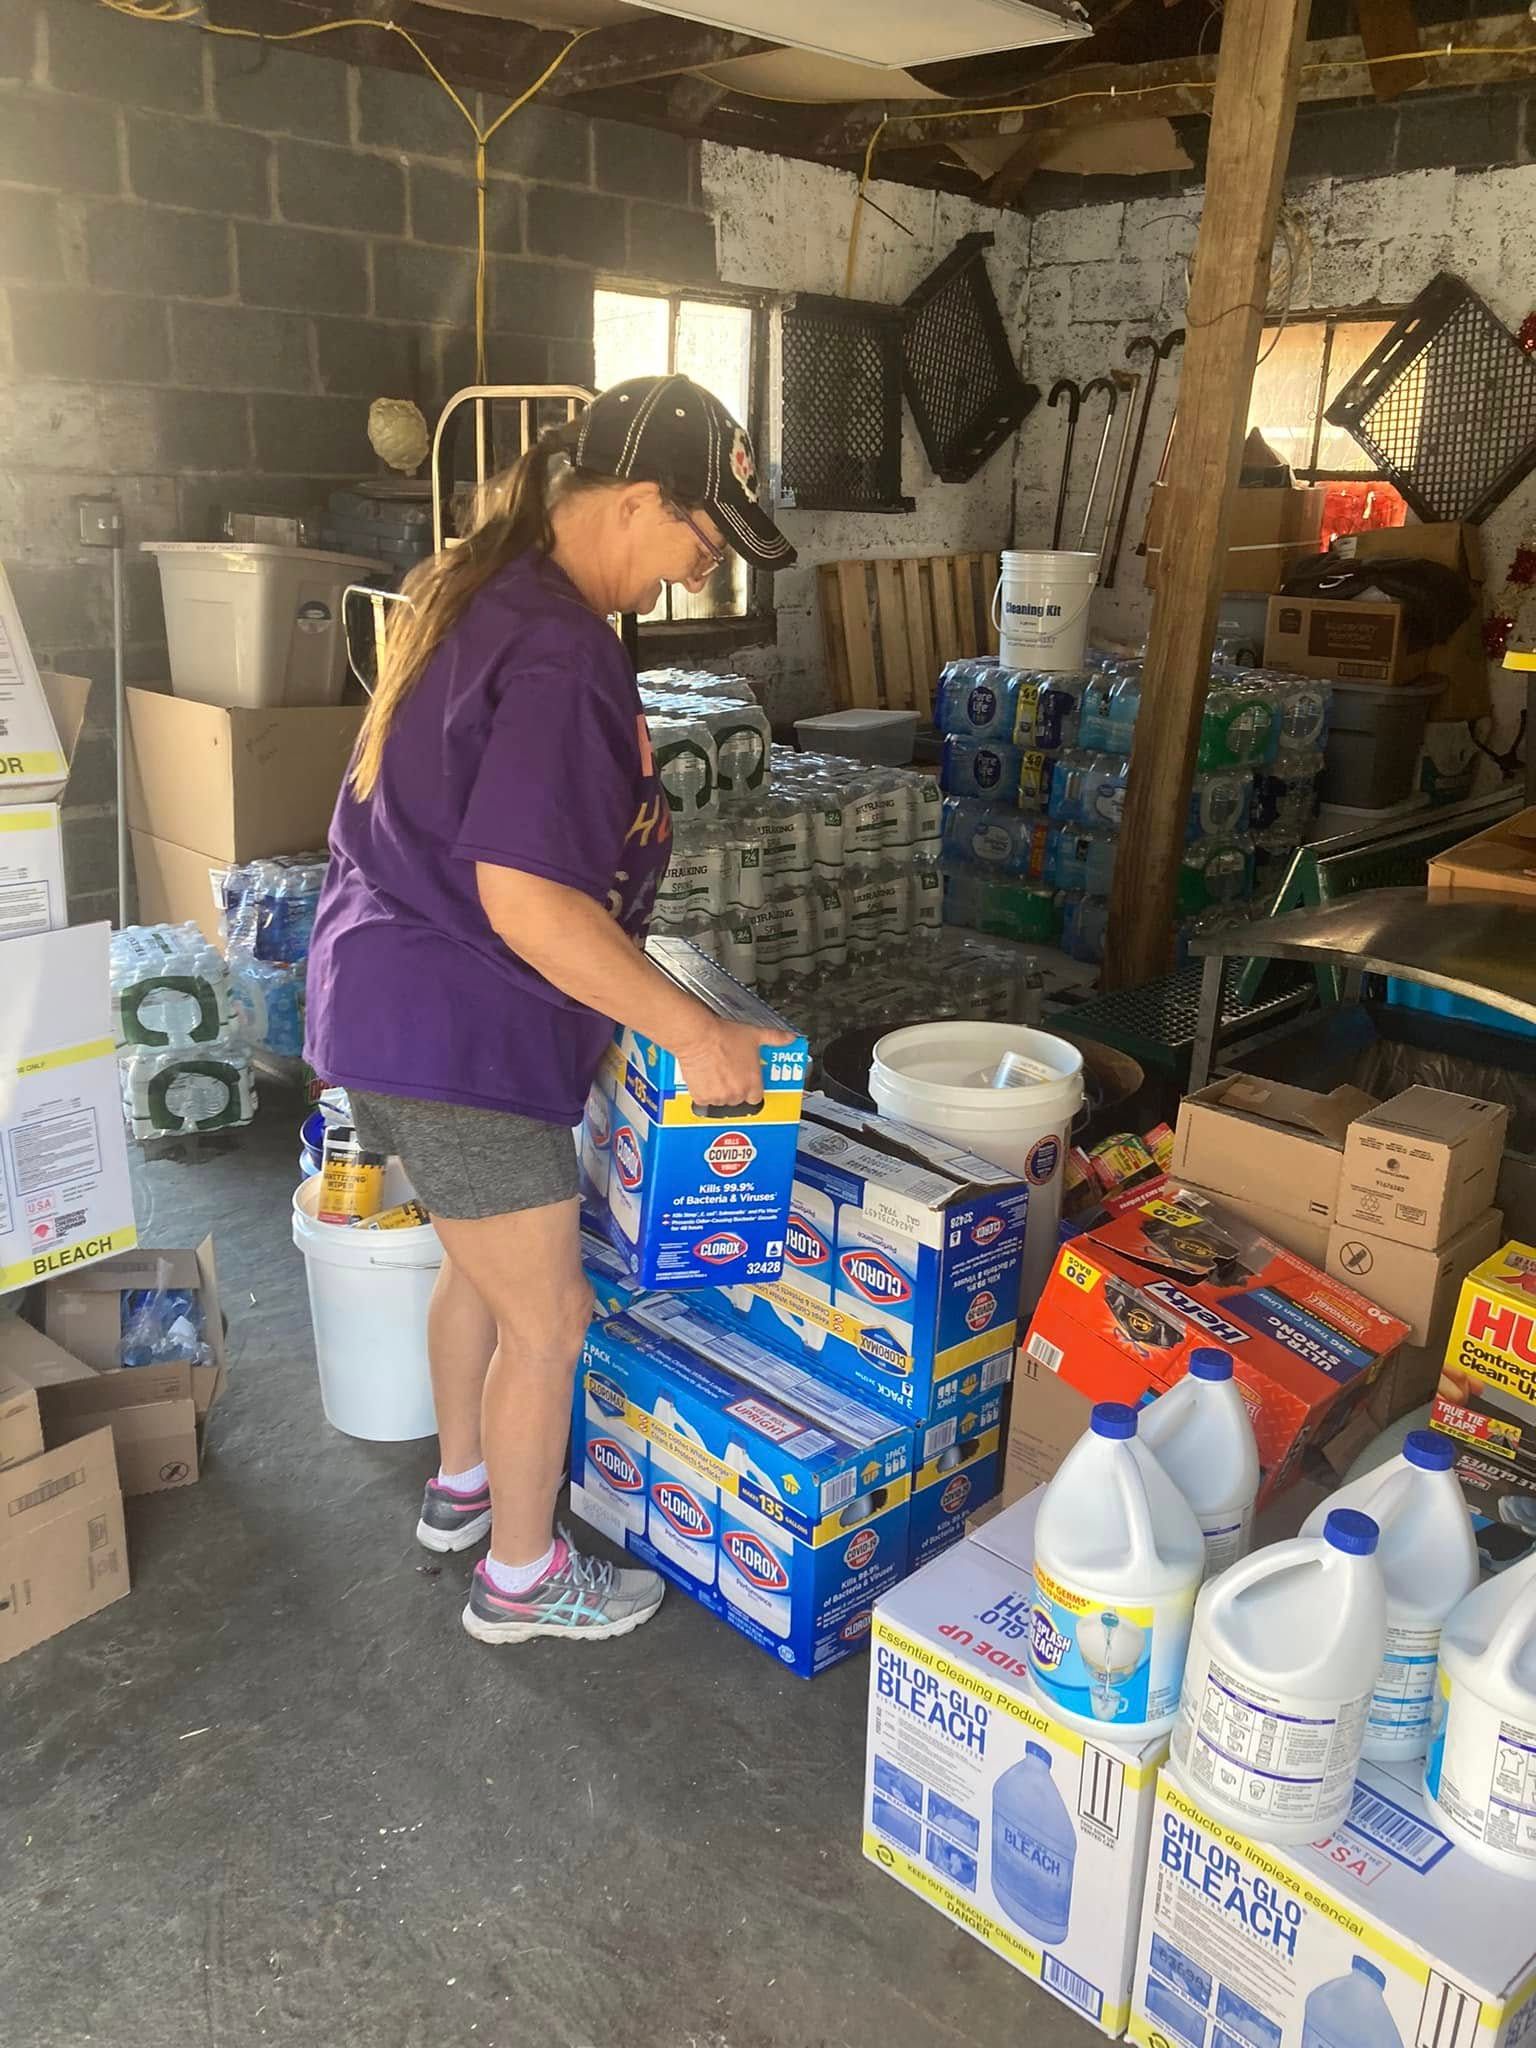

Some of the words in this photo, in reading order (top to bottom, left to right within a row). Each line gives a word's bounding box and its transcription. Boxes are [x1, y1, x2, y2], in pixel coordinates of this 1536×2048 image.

[1005, 602, 1044, 617] Cleaning
[1046, 604, 1061, 616] Kit
[708, 1147, 752, 1161] COVID-19
[673, 1196, 684, 1206] of
[686, 1195, 728, 1206] Bacteria
[729, 1194, 737, 1203] &
[699, 1183, 721, 1194] Kills
[723, 1182, 754, 1193] 99.9%
[1153, 1208, 1183, 1223] 90
[33, 1236, 113, 1276] BLEACH
[699, 1241, 740, 1257] CLOROX
[746, 1261, 781, 1275] 32428
[849, 1257, 901, 1298] CLOROX
[1066, 1265, 1088, 1286] 90
[1068, 1256, 1093, 1277] BAGS
[1154, 1285, 1244, 1344] Hefty
[1282, 1307, 1303, 1323] Can
[1367, 1306, 1392, 1325] 90
[1267, 1316, 1342, 1367] STRONG
[1303, 1320, 1330, 1341] Trash
[589, 1346, 611, 1365] PACK
[860, 1335, 906, 1369] CLOROMAX
[1275, 1330, 1334, 1373] ULTRA
[588, 1377, 625, 1410] CLOROMAX
[878, 1387, 904, 1405] PACK
[906, 1400, 914, 1410] 3
[734, 1405, 787, 1437] UPRIGHT
[1437, 1401, 1466, 1420] TRUE
[1466, 1411, 1486, 1427] TIE
[1442, 1414, 1477, 1434] FLAPS
[594, 1443, 635, 1486] CLOROX
[1461, 1455, 1518, 1482] GLOVES
[783, 1479, 799, 1496] UP
[659, 1486, 704, 1532] CLOROX
[741, 1487, 760, 1503] MAKES
[758, 1492, 785, 1522] 135
[784, 1515, 809, 1536] GALLONS
[731, 1537, 779, 1585] CLOROX
[846, 1537, 877, 1561] COVID-19
[735, 1577, 773, 1608] Performance
[823, 1596, 832, 1608] of
[832, 1583, 862, 1603] Bacteria
[863, 1578, 869, 1587] &
[841, 1577, 858, 1590] Kills
[937, 1623, 974, 1646] UP
[972, 1640, 1027, 1677] SIDE
[877, 1625, 934, 1666] Essential
[936, 1660, 993, 1702] Cleaning
[995, 1693, 1050, 1734] Product
[877, 1646, 989, 1727] CHLOR-GLO
[877, 1667, 986, 1755] BLEACH
[1004, 1827, 1061, 1877] BLEACH
[1165, 1790, 1222, 1837] Producto
[1224, 1833, 1243, 1851] de
[1244, 1846, 1301, 1894] limpieza
[1303, 1888, 1364, 1937] esencial
[1163, 1812, 1302, 1927] CHLOR-GLO
[1160, 1834, 1298, 1957] BLEACH
[907, 1864, 927, 1882] KEEP
[927, 1879, 944, 1894] OUT
[945, 1889, 956, 1901] OF
[956, 1898, 984, 1923] REACH
[984, 1918, 995, 1930] OF
[995, 1926, 1035, 1961] CHILDREN
[946, 1901, 991, 1939] DANGER
